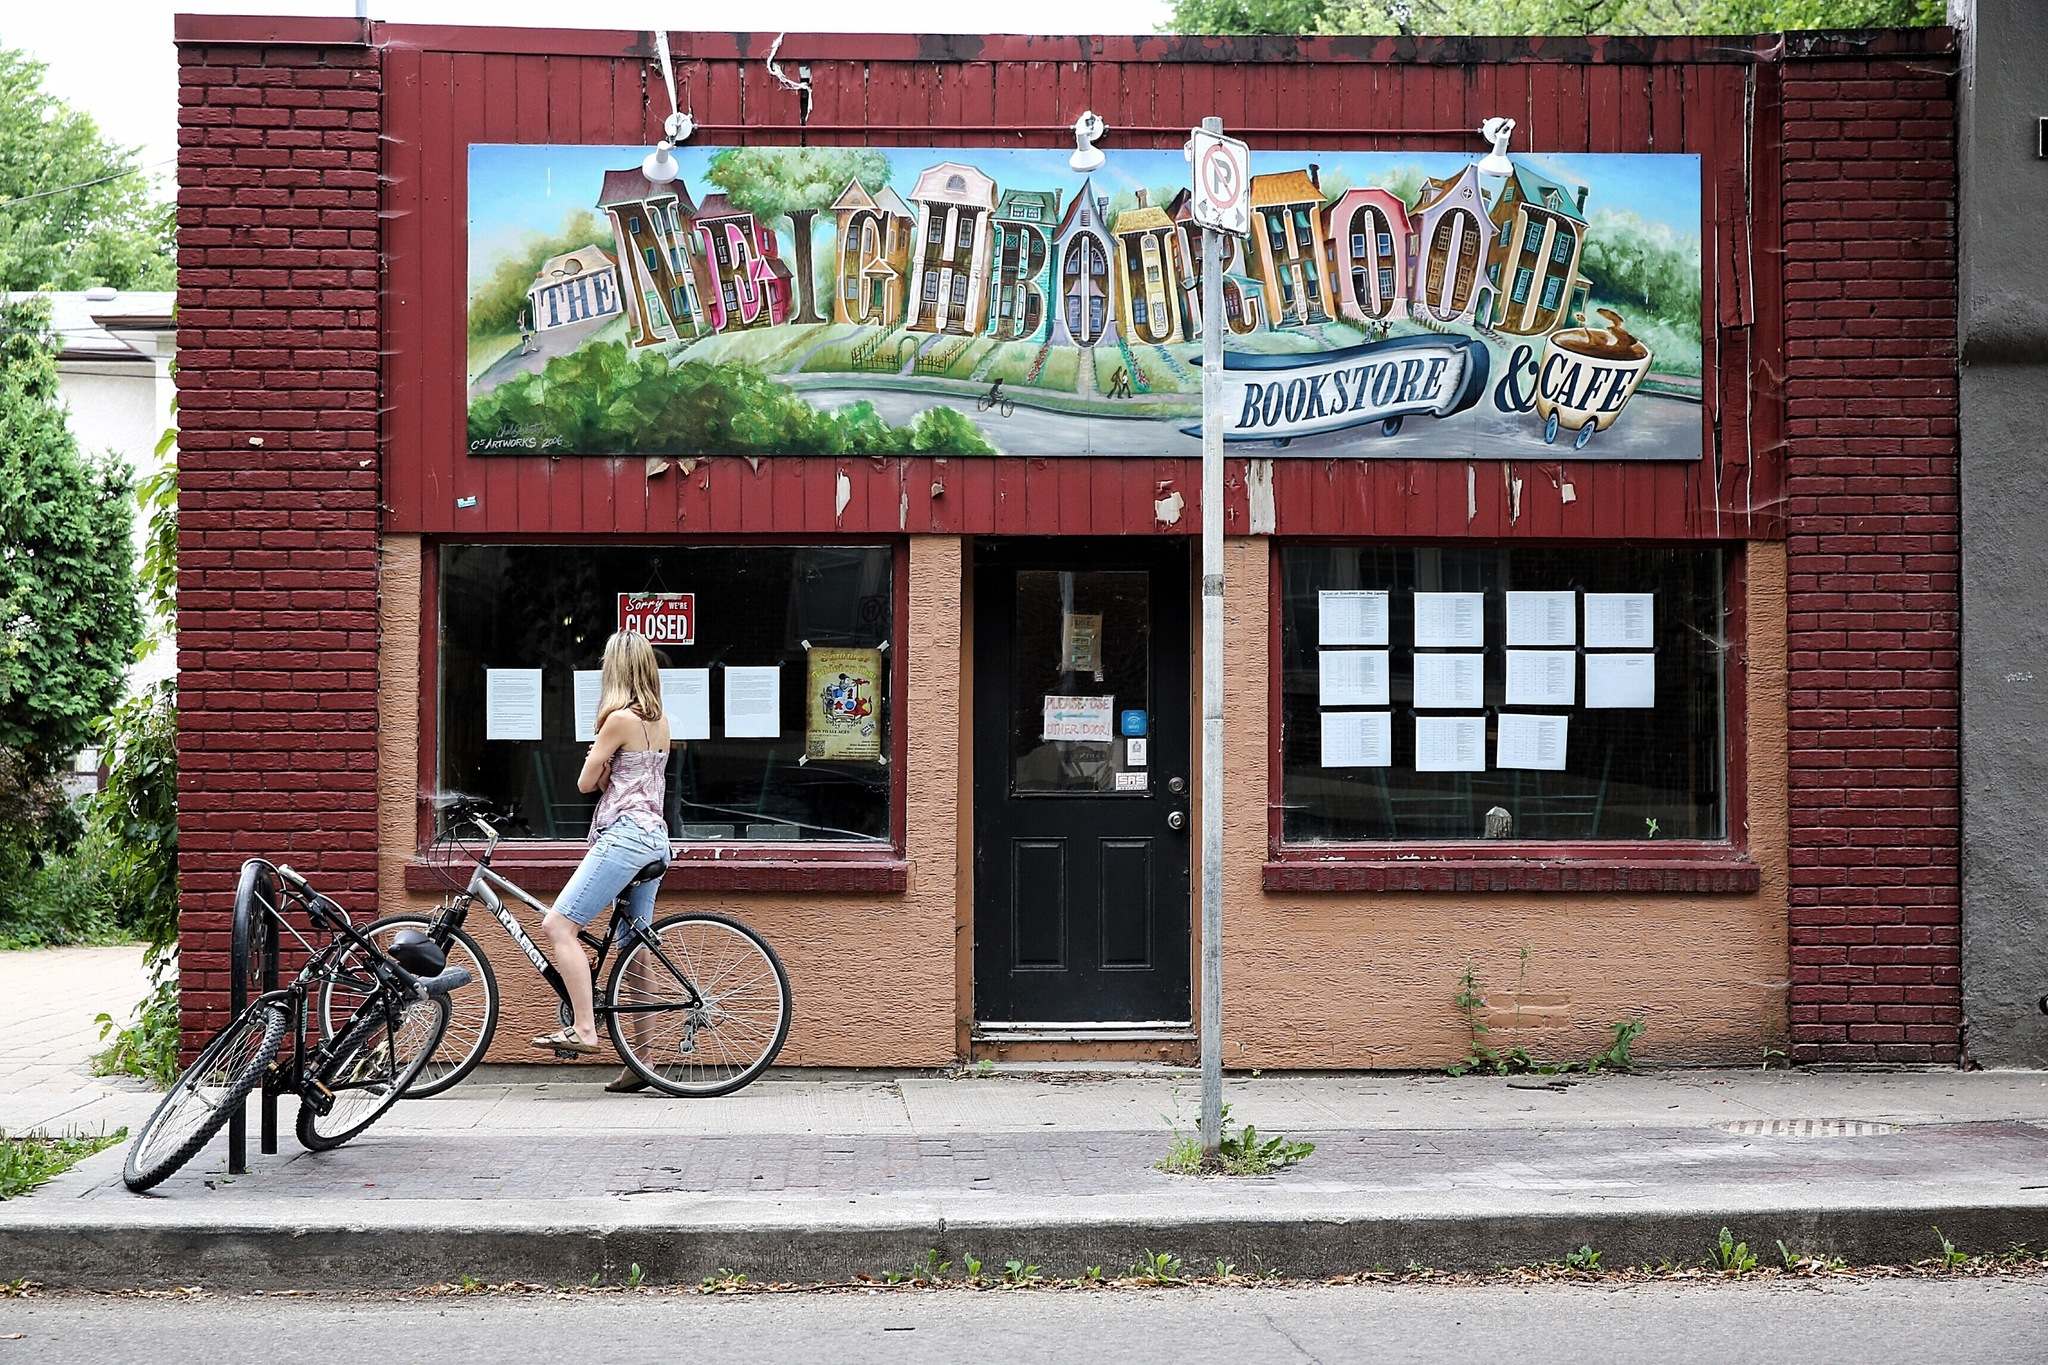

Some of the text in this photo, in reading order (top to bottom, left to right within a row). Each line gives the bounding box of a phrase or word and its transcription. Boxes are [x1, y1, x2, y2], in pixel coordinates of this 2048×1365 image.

[540, 271, 619, 328] THE
[1235, 357, 1449, 429] BOOKSTORE
[1493, 344, 1639, 414] & CAFE
[485, 437, 537, 449] ARTWORKS
[625, 598, 688, 614] Sorry WE'RE
[625, 614, 688, 640] CLOSED
[1046, 723, 1079, 735] OTHER
[498, 908, 549, 973] RALEIGH
